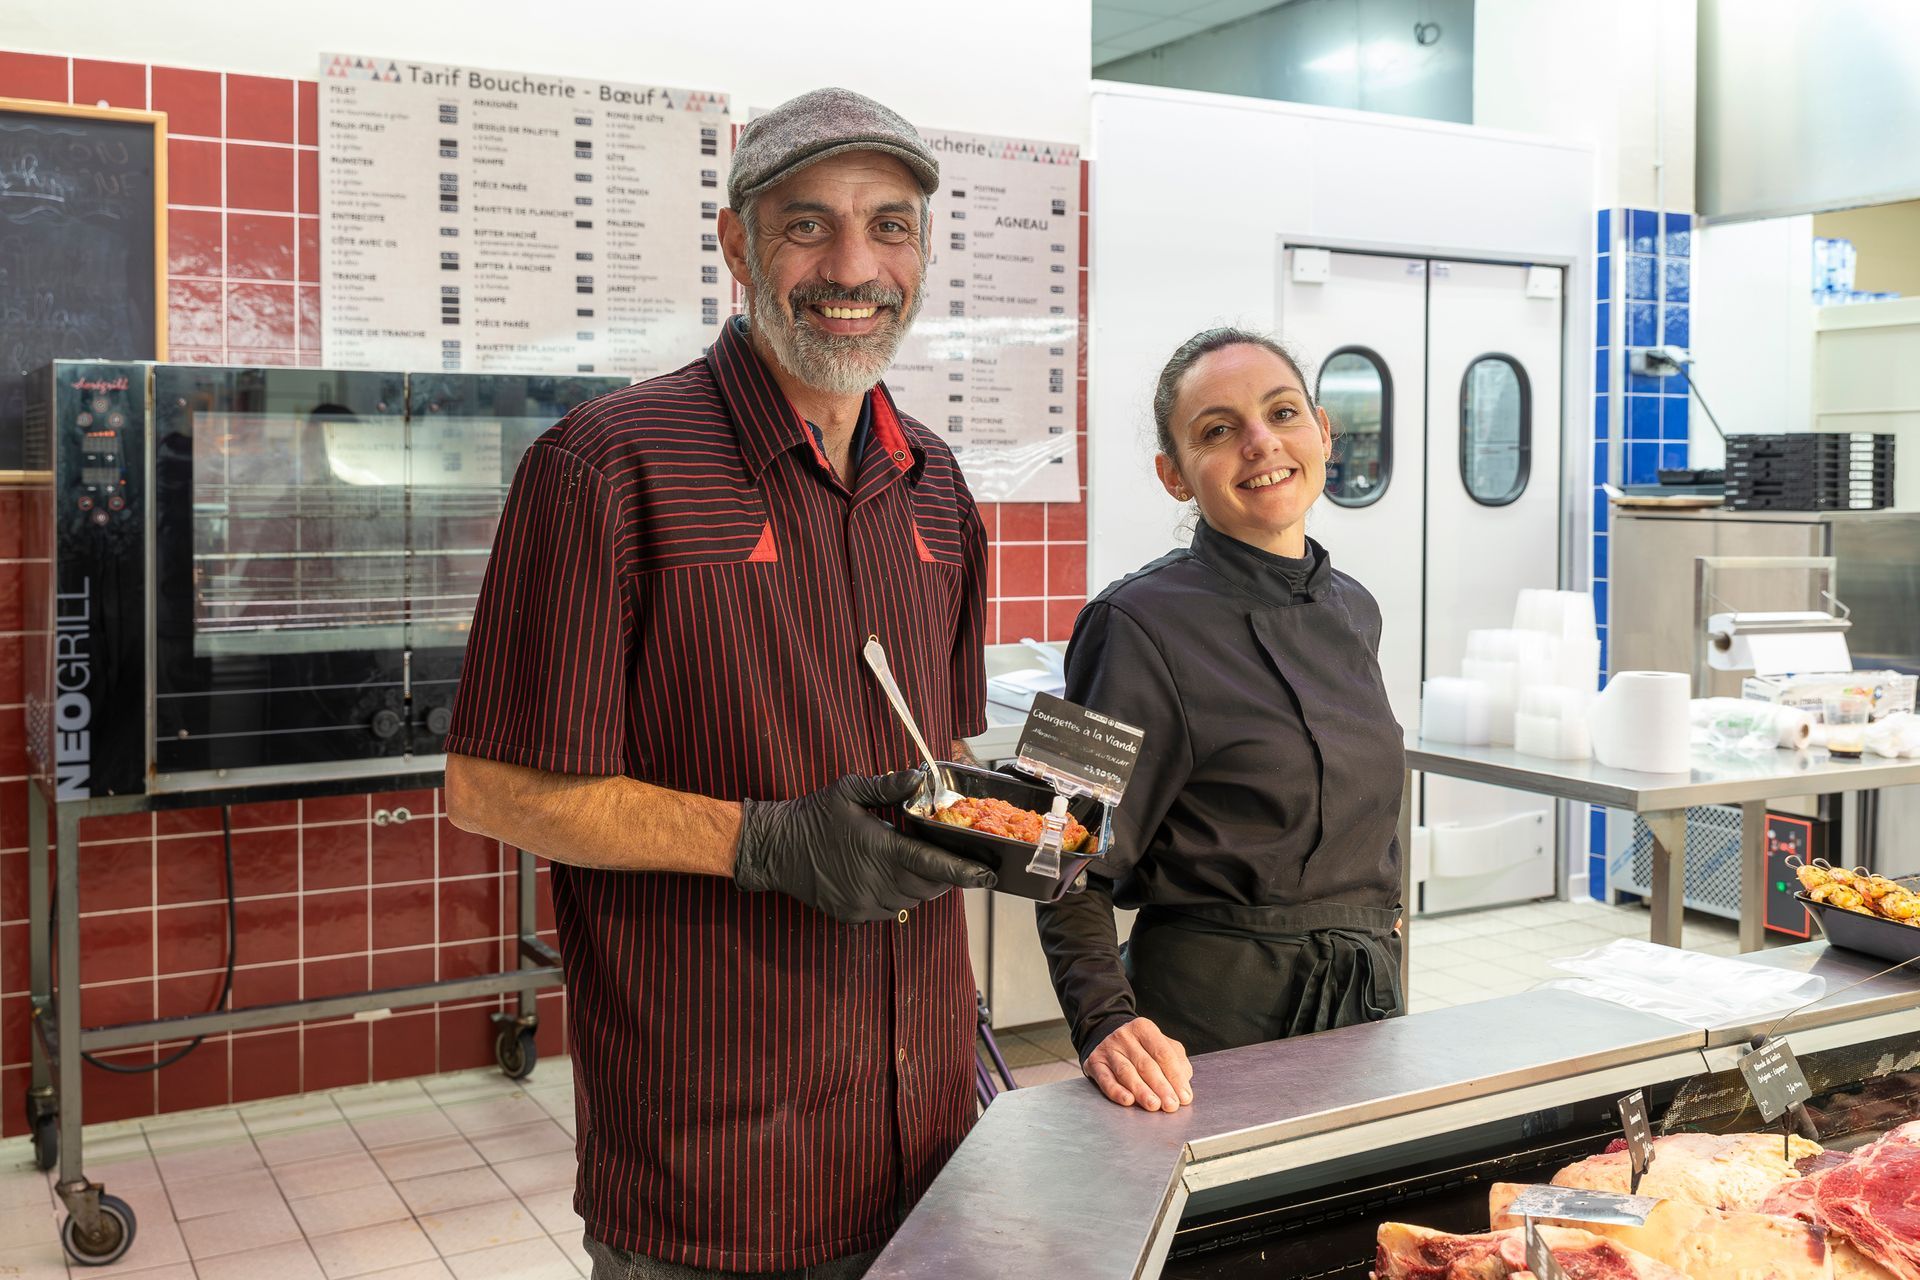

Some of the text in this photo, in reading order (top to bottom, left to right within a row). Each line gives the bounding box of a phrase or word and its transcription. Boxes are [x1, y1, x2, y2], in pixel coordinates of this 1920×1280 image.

[407, 65, 461, 86] Tarif
[468, 71, 576, 99] Boucherie
[600, 85, 655, 106] Bœuf
[922, 134, 987, 156] ucherie
[995, 216, 1049, 231] AGNEAU
[56, 576, 92, 803] NEOGRILL
[1032, 708, 1080, 734] Courgettes
[1083, 726, 1091, 737] à
[1092, 729, 1103, 742] la
[1105, 734, 1137, 754] Viande
